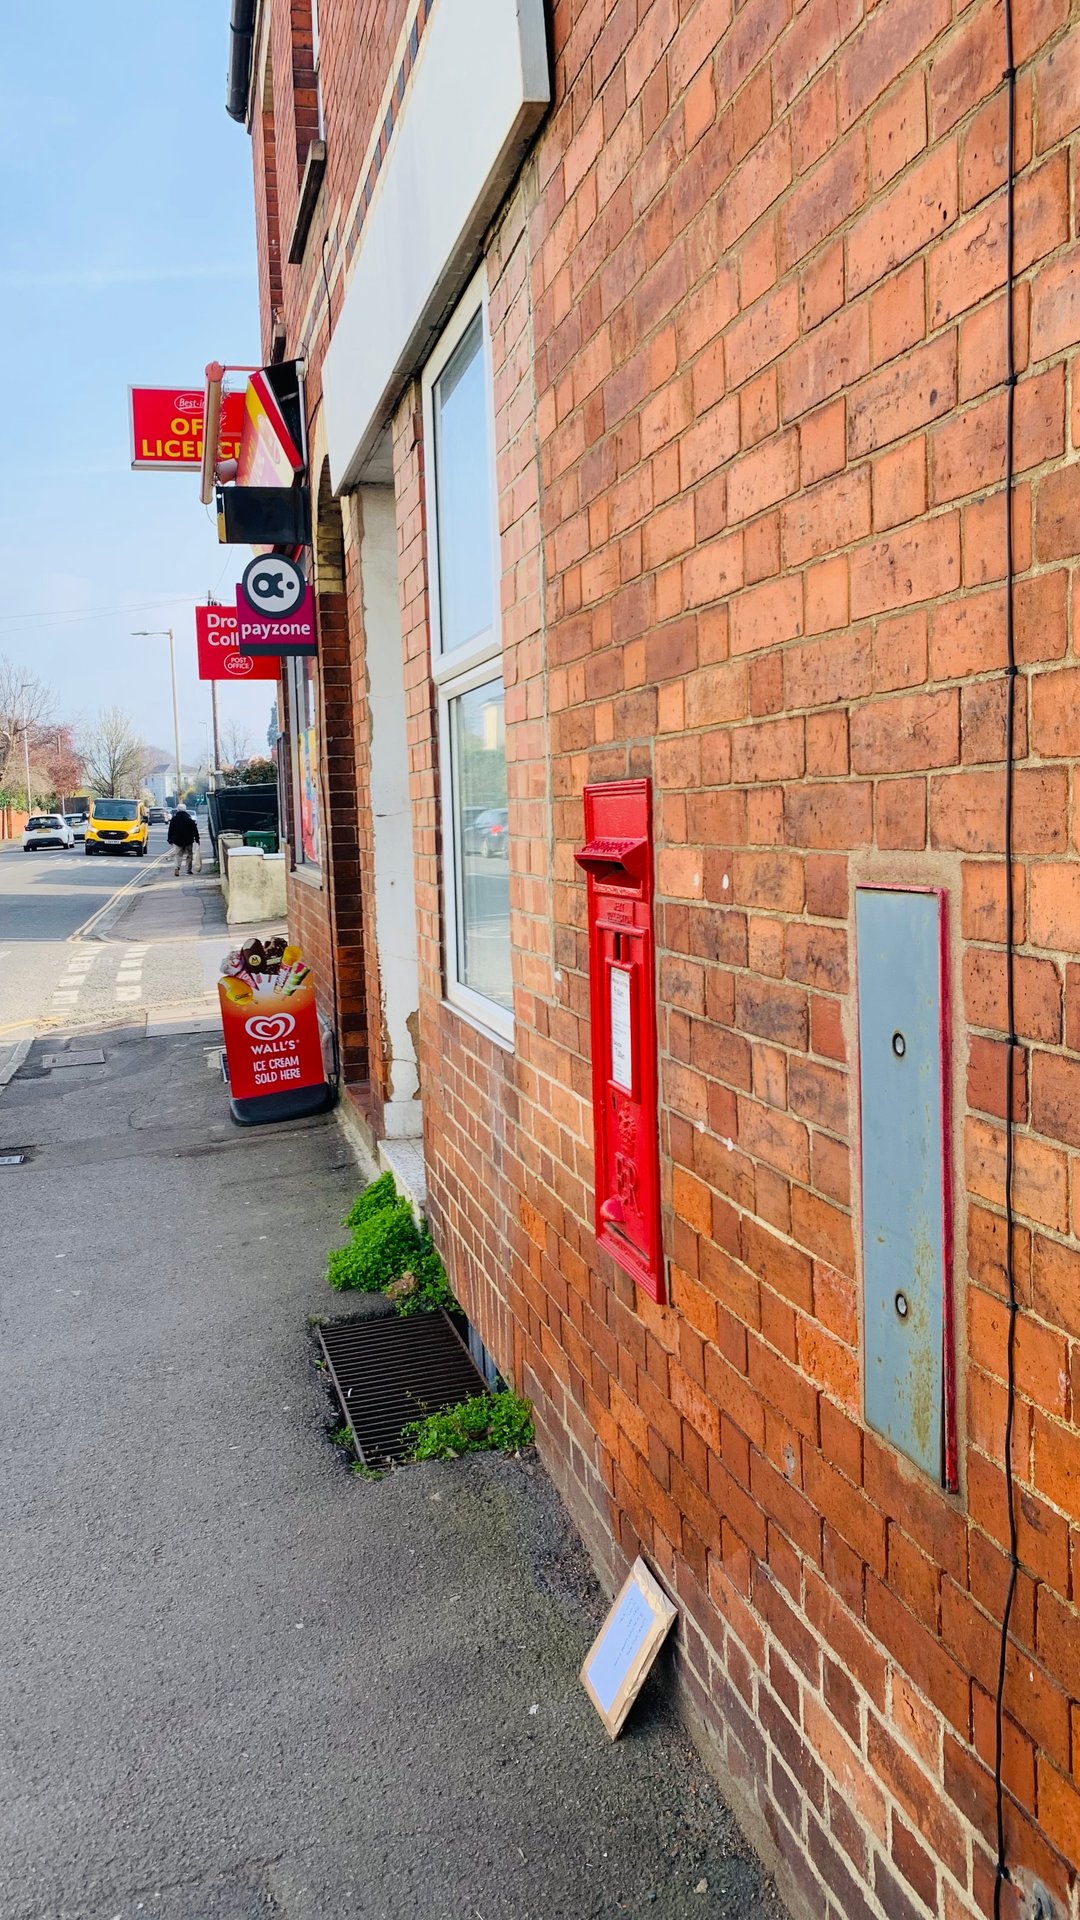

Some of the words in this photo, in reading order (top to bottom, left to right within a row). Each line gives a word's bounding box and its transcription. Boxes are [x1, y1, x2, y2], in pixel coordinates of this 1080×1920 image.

[171, 418, 204, 435] OF
[207, 614, 237, 628] Dro
[208, 632, 239, 646] Coll
[241, 623, 311, 639] payzone
[250, 1040, 296, 1055] WALL'S
[253, 1060, 267, 1072] ICE
[269, 1055, 300, 1069] CREAM
[255, 1071, 278, 1085] SOLD
[280, 1067, 301, 1080] HERE
